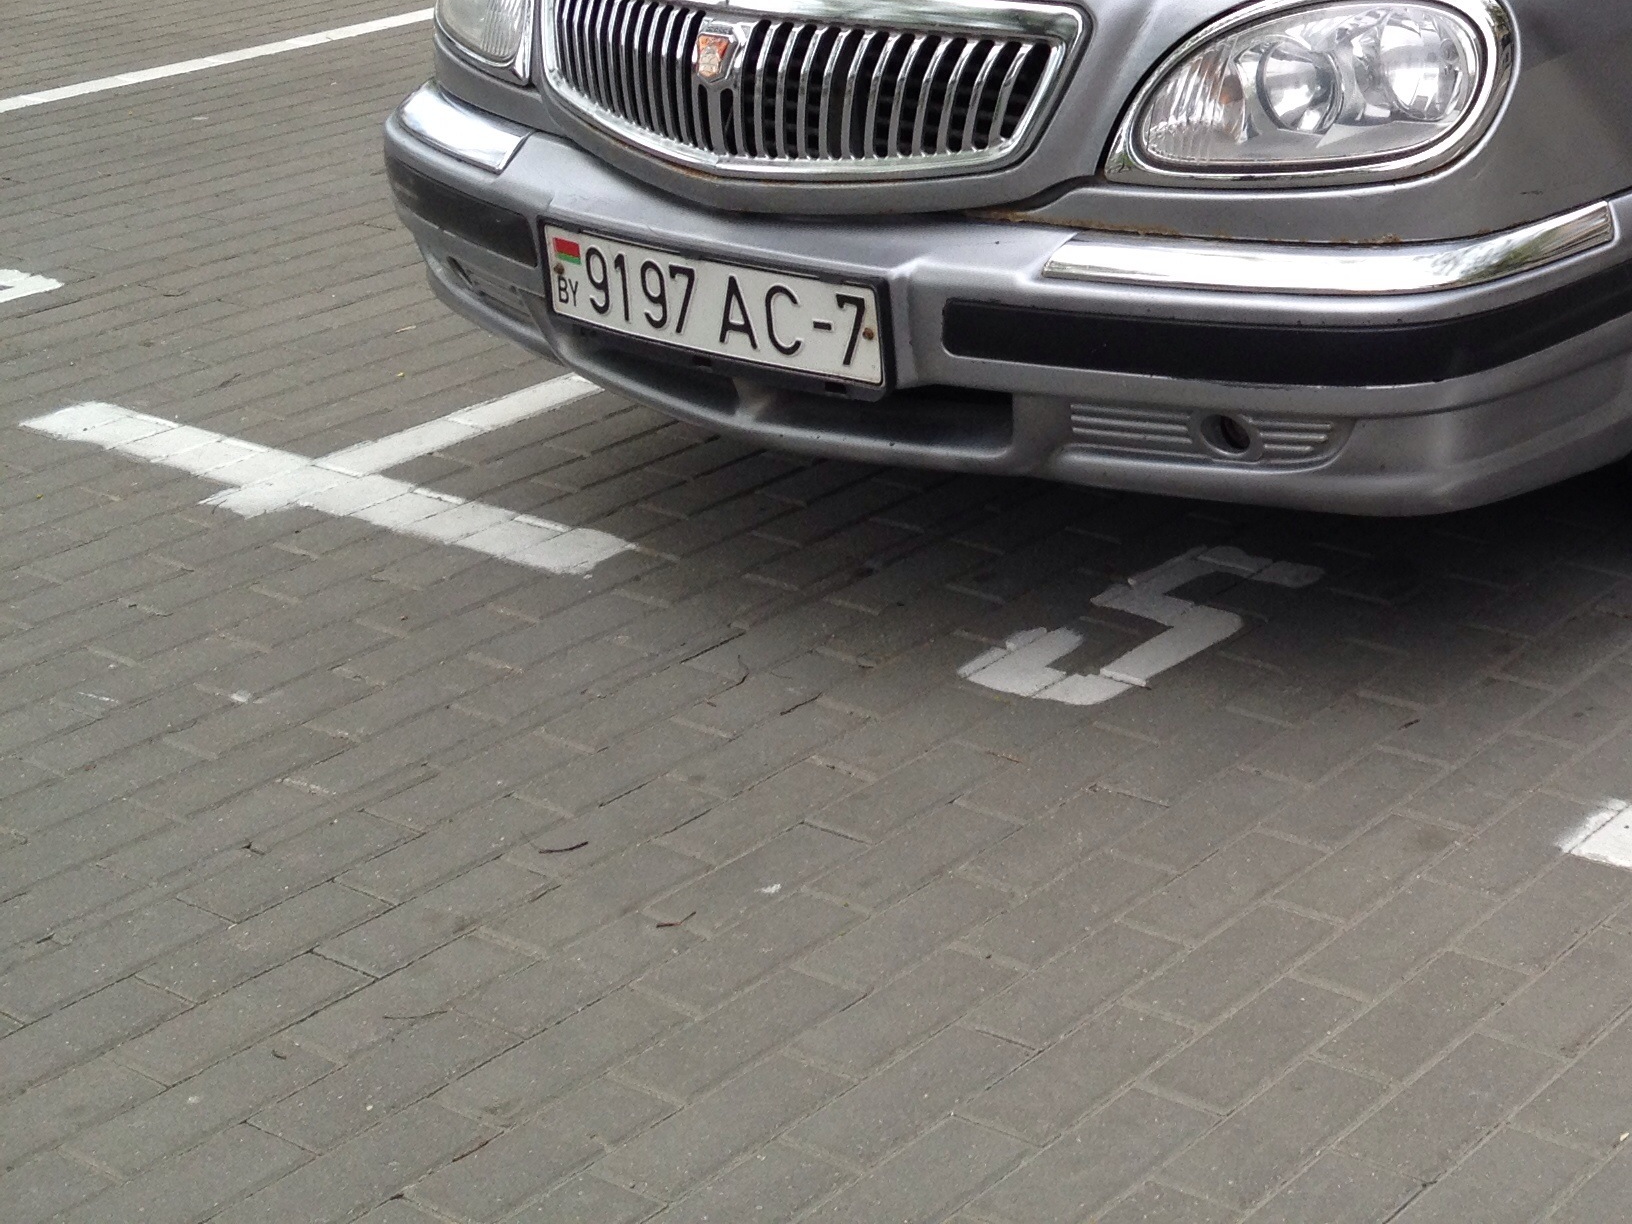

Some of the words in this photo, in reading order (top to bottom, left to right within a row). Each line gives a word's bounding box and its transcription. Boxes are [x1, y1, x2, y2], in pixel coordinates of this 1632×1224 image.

[557, 276, 579, 307] BY
[585, 246, 697, 334] 9197
[718, 275, 866, 366] AC-7
[957, 545, 1326, 706] 5
